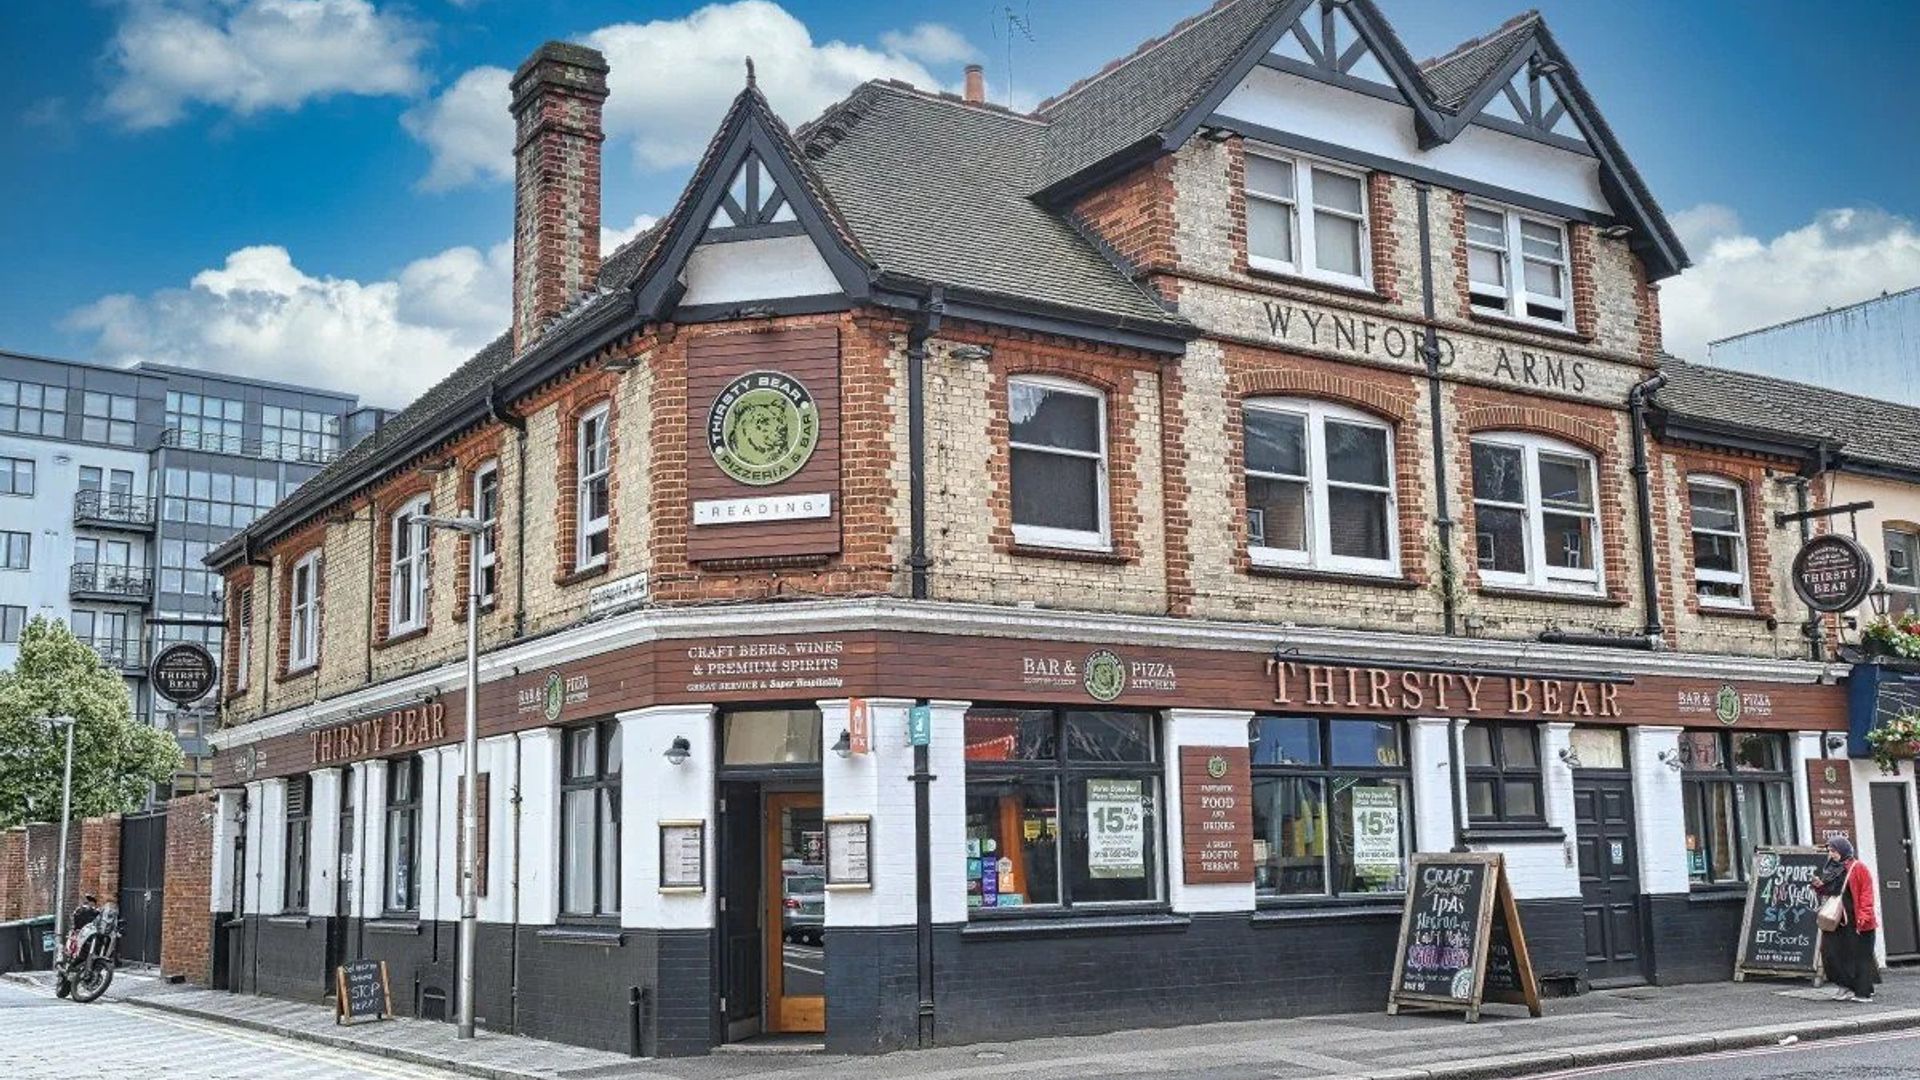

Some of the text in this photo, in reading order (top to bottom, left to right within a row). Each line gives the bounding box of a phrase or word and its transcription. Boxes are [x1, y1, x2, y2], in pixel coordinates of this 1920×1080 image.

[1263, 302, 1585, 393] WYNFORD ARMS
[711, 376, 801, 444] THIRSTY BEAR
[720, 413, 812, 481] PIZZERIA & BAR
[711, 502, 813, 518] READING
[1801, 568, 1857, 584] THIRSTY
[1814, 581, 1847, 594] BEAR
[687, 640, 844, 659] CRAFT BEERS, WINES
[692, 658, 839, 676] & PREMIUM SPIRITS
[1022, 657, 1175, 678] BAR & PIZZA
[160, 671, 208, 680] THIRSTY
[169, 680, 198, 689] BEAR
[686, 682, 718, 692] GREAT
[718, 680, 758, 691] SERVICE
[760, 680, 768, 689] &
[769, 679, 795, 690] Super
[1131, 679, 1177, 690] KITCHEN
[1266, 658, 1624, 717] THIRSTY BEAR
[1678, 691, 1771, 707] BAR & PIZZA
[310, 702, 445, 764] THIRSTY BEAR
[1201, 797, 1235, 809] FOOD
[1211, 811, 1226, 819] AND
[1202, 821, 1235, 831] DRINKS
[1201, 850, 1240, 860] ROOFTOP
[1201, 861, 1240, 872] TERRACE
[1760, 877, 1773, 904] 4
[1764, 906, 1807, 923] SKY
[1779, 920, 1787, 932] &
[351, 981, 381, 999] STOP
